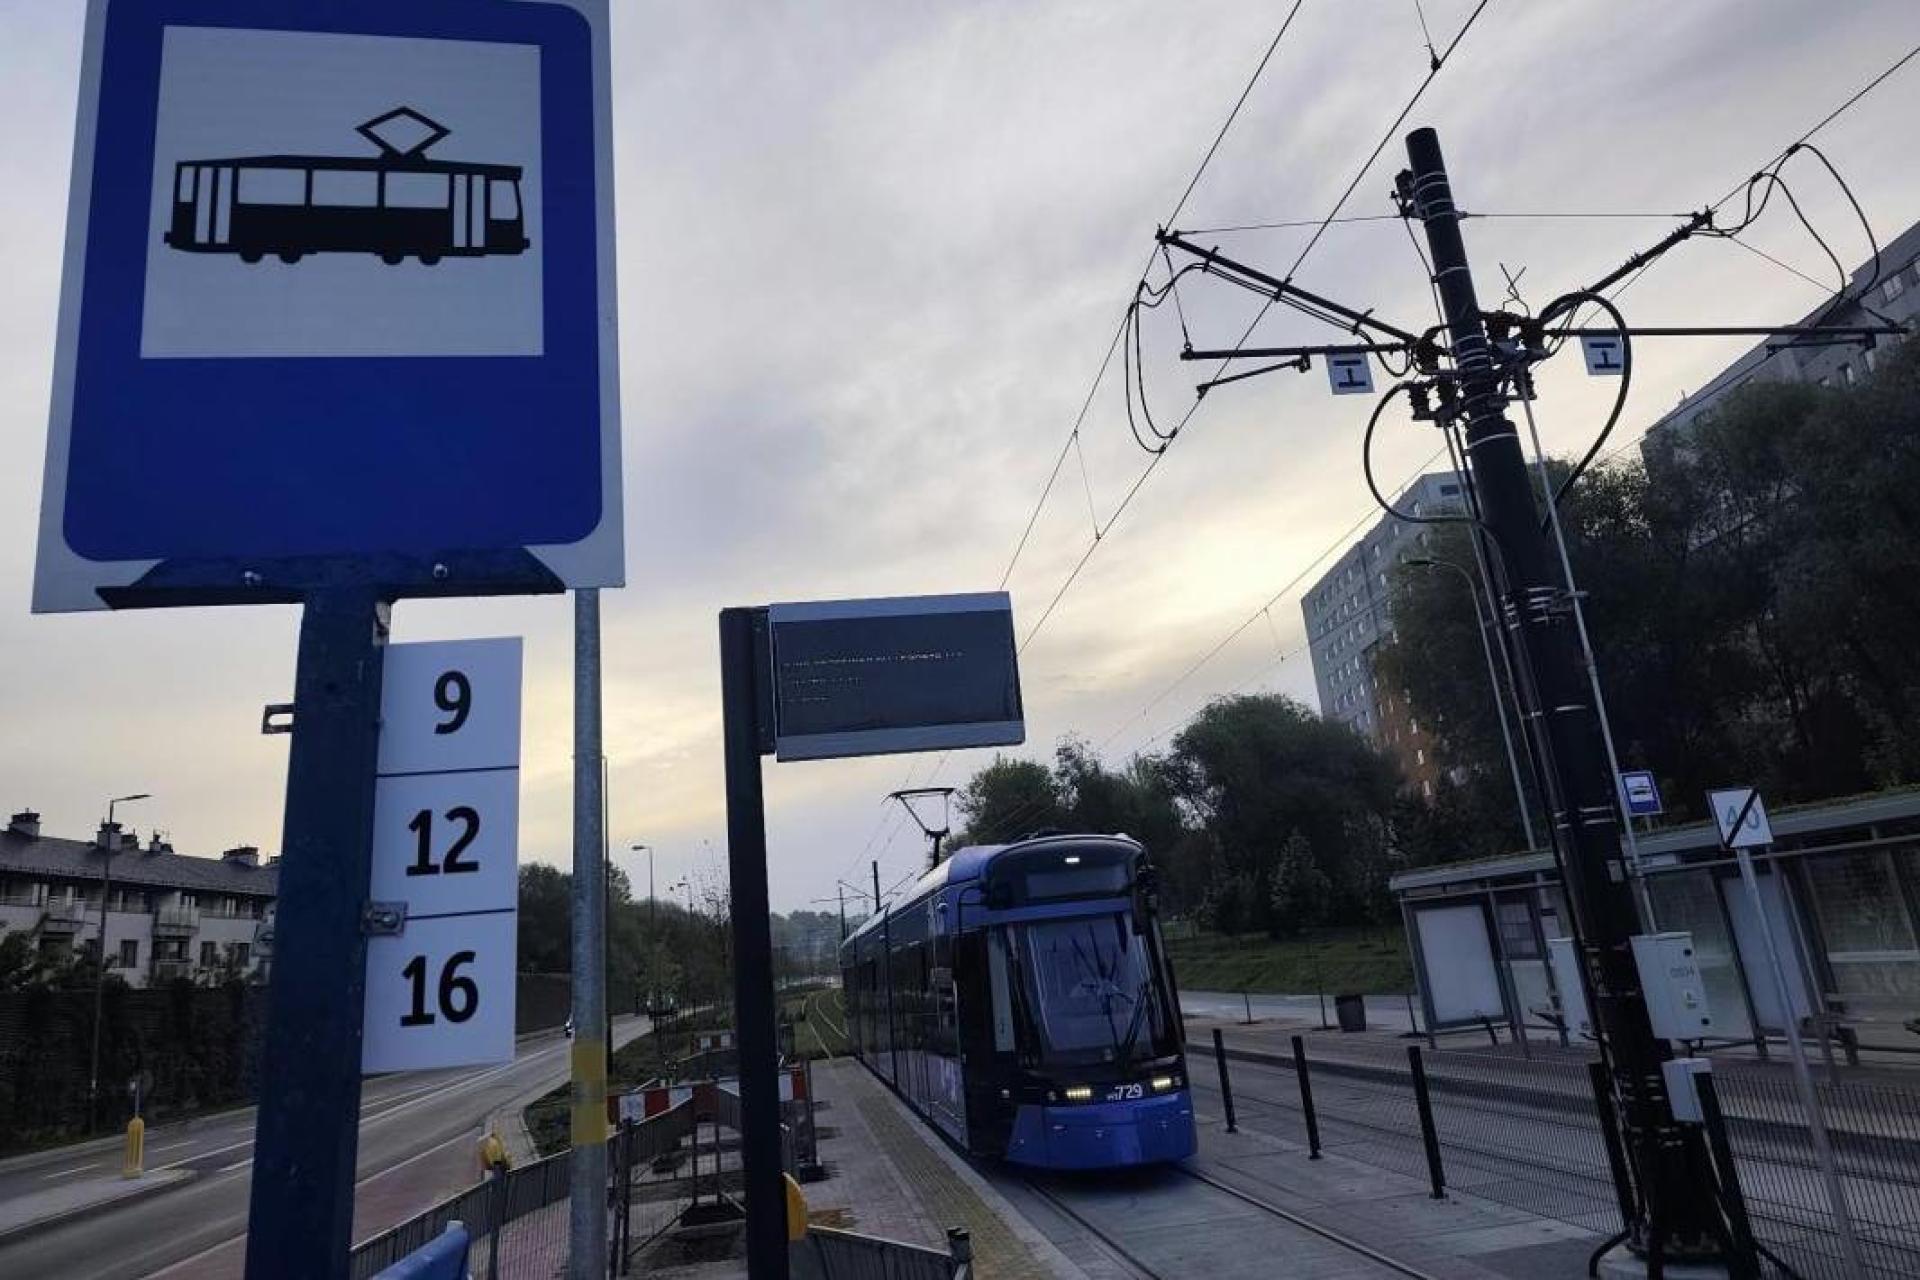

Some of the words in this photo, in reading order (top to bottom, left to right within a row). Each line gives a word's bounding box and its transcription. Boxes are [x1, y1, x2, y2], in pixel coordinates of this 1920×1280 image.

[434, 670, 471, 735] 9
[406, 806, 480, 876] 12
[400, 950, 479, 1027] 16
